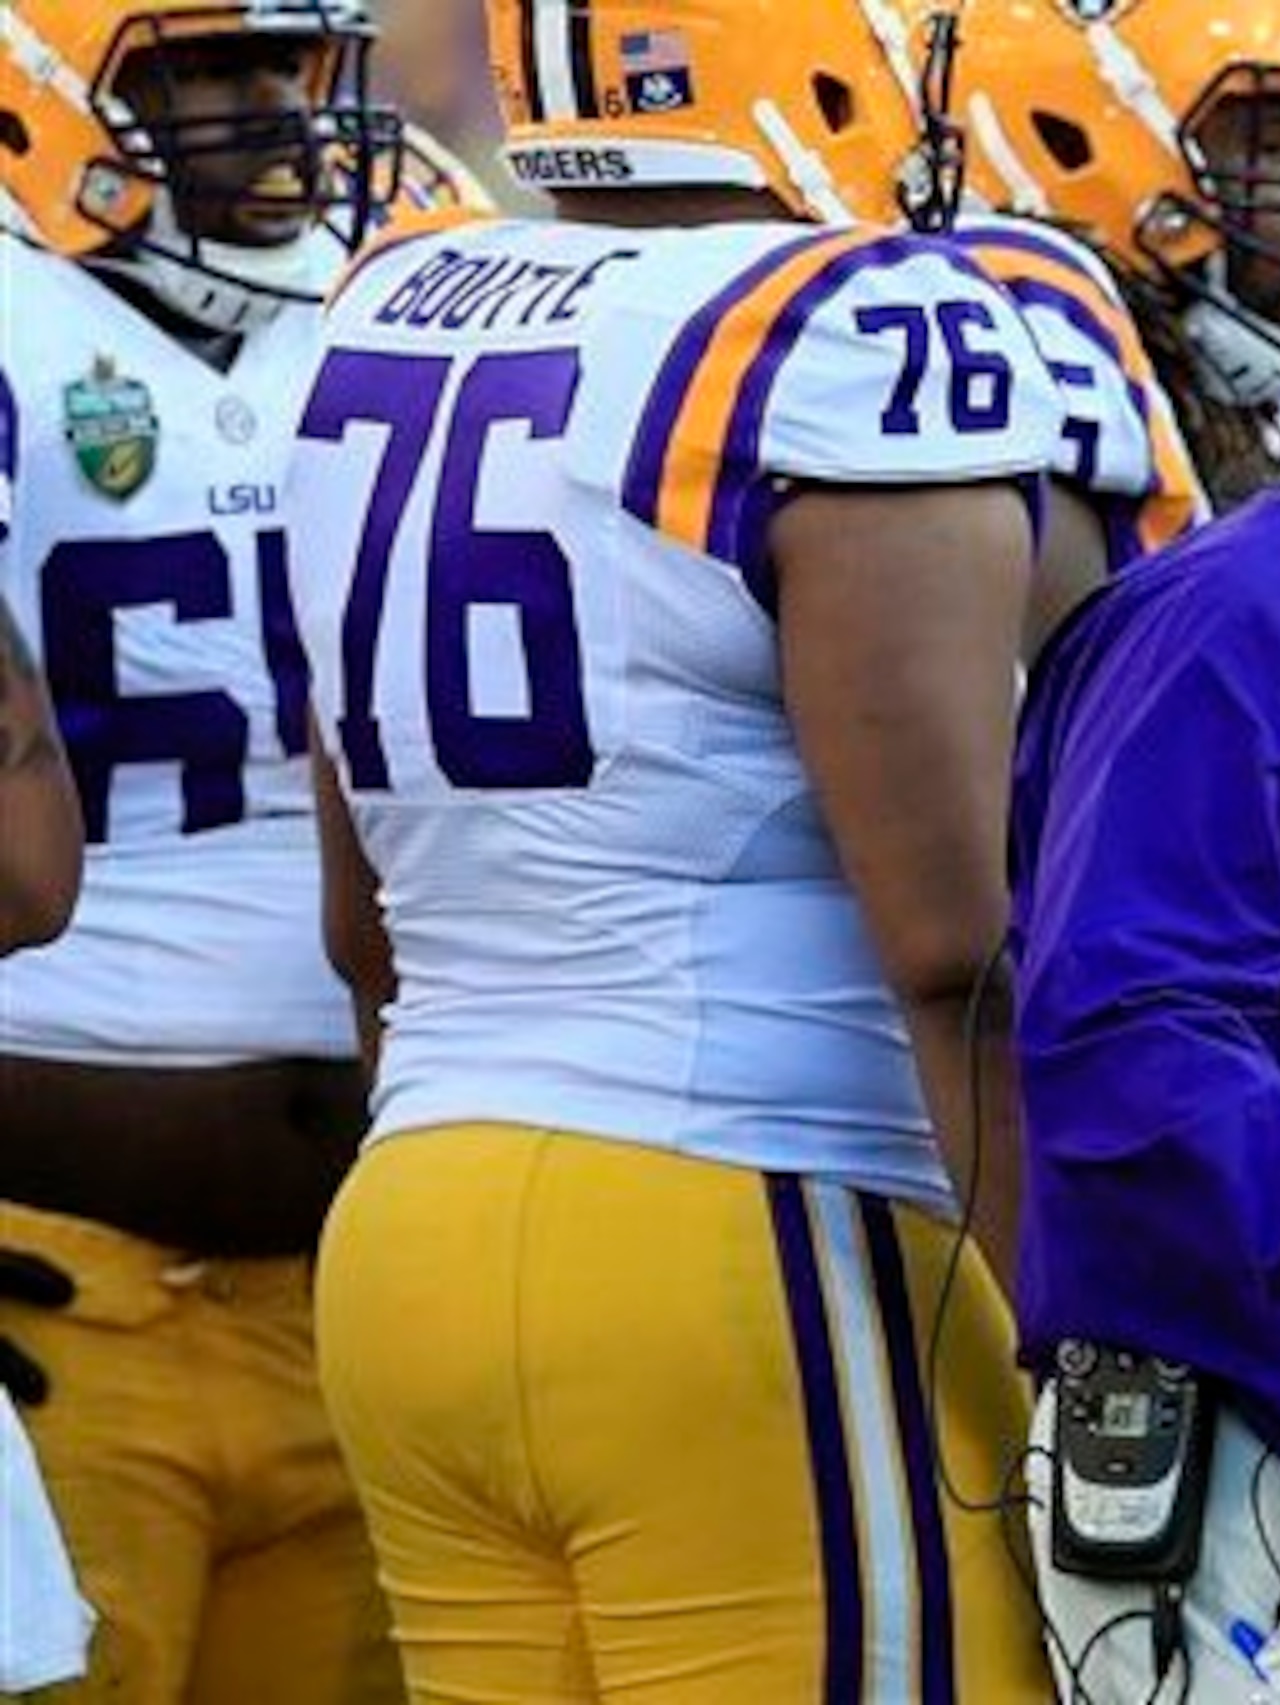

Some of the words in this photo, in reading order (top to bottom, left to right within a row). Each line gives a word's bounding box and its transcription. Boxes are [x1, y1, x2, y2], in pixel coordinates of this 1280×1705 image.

[509, 148, 633, 181] TIGERS
[854, 301, 1011, 434] 76
[209, 485, 275, 515] LSU
[296, 345, 596, 790] 76
